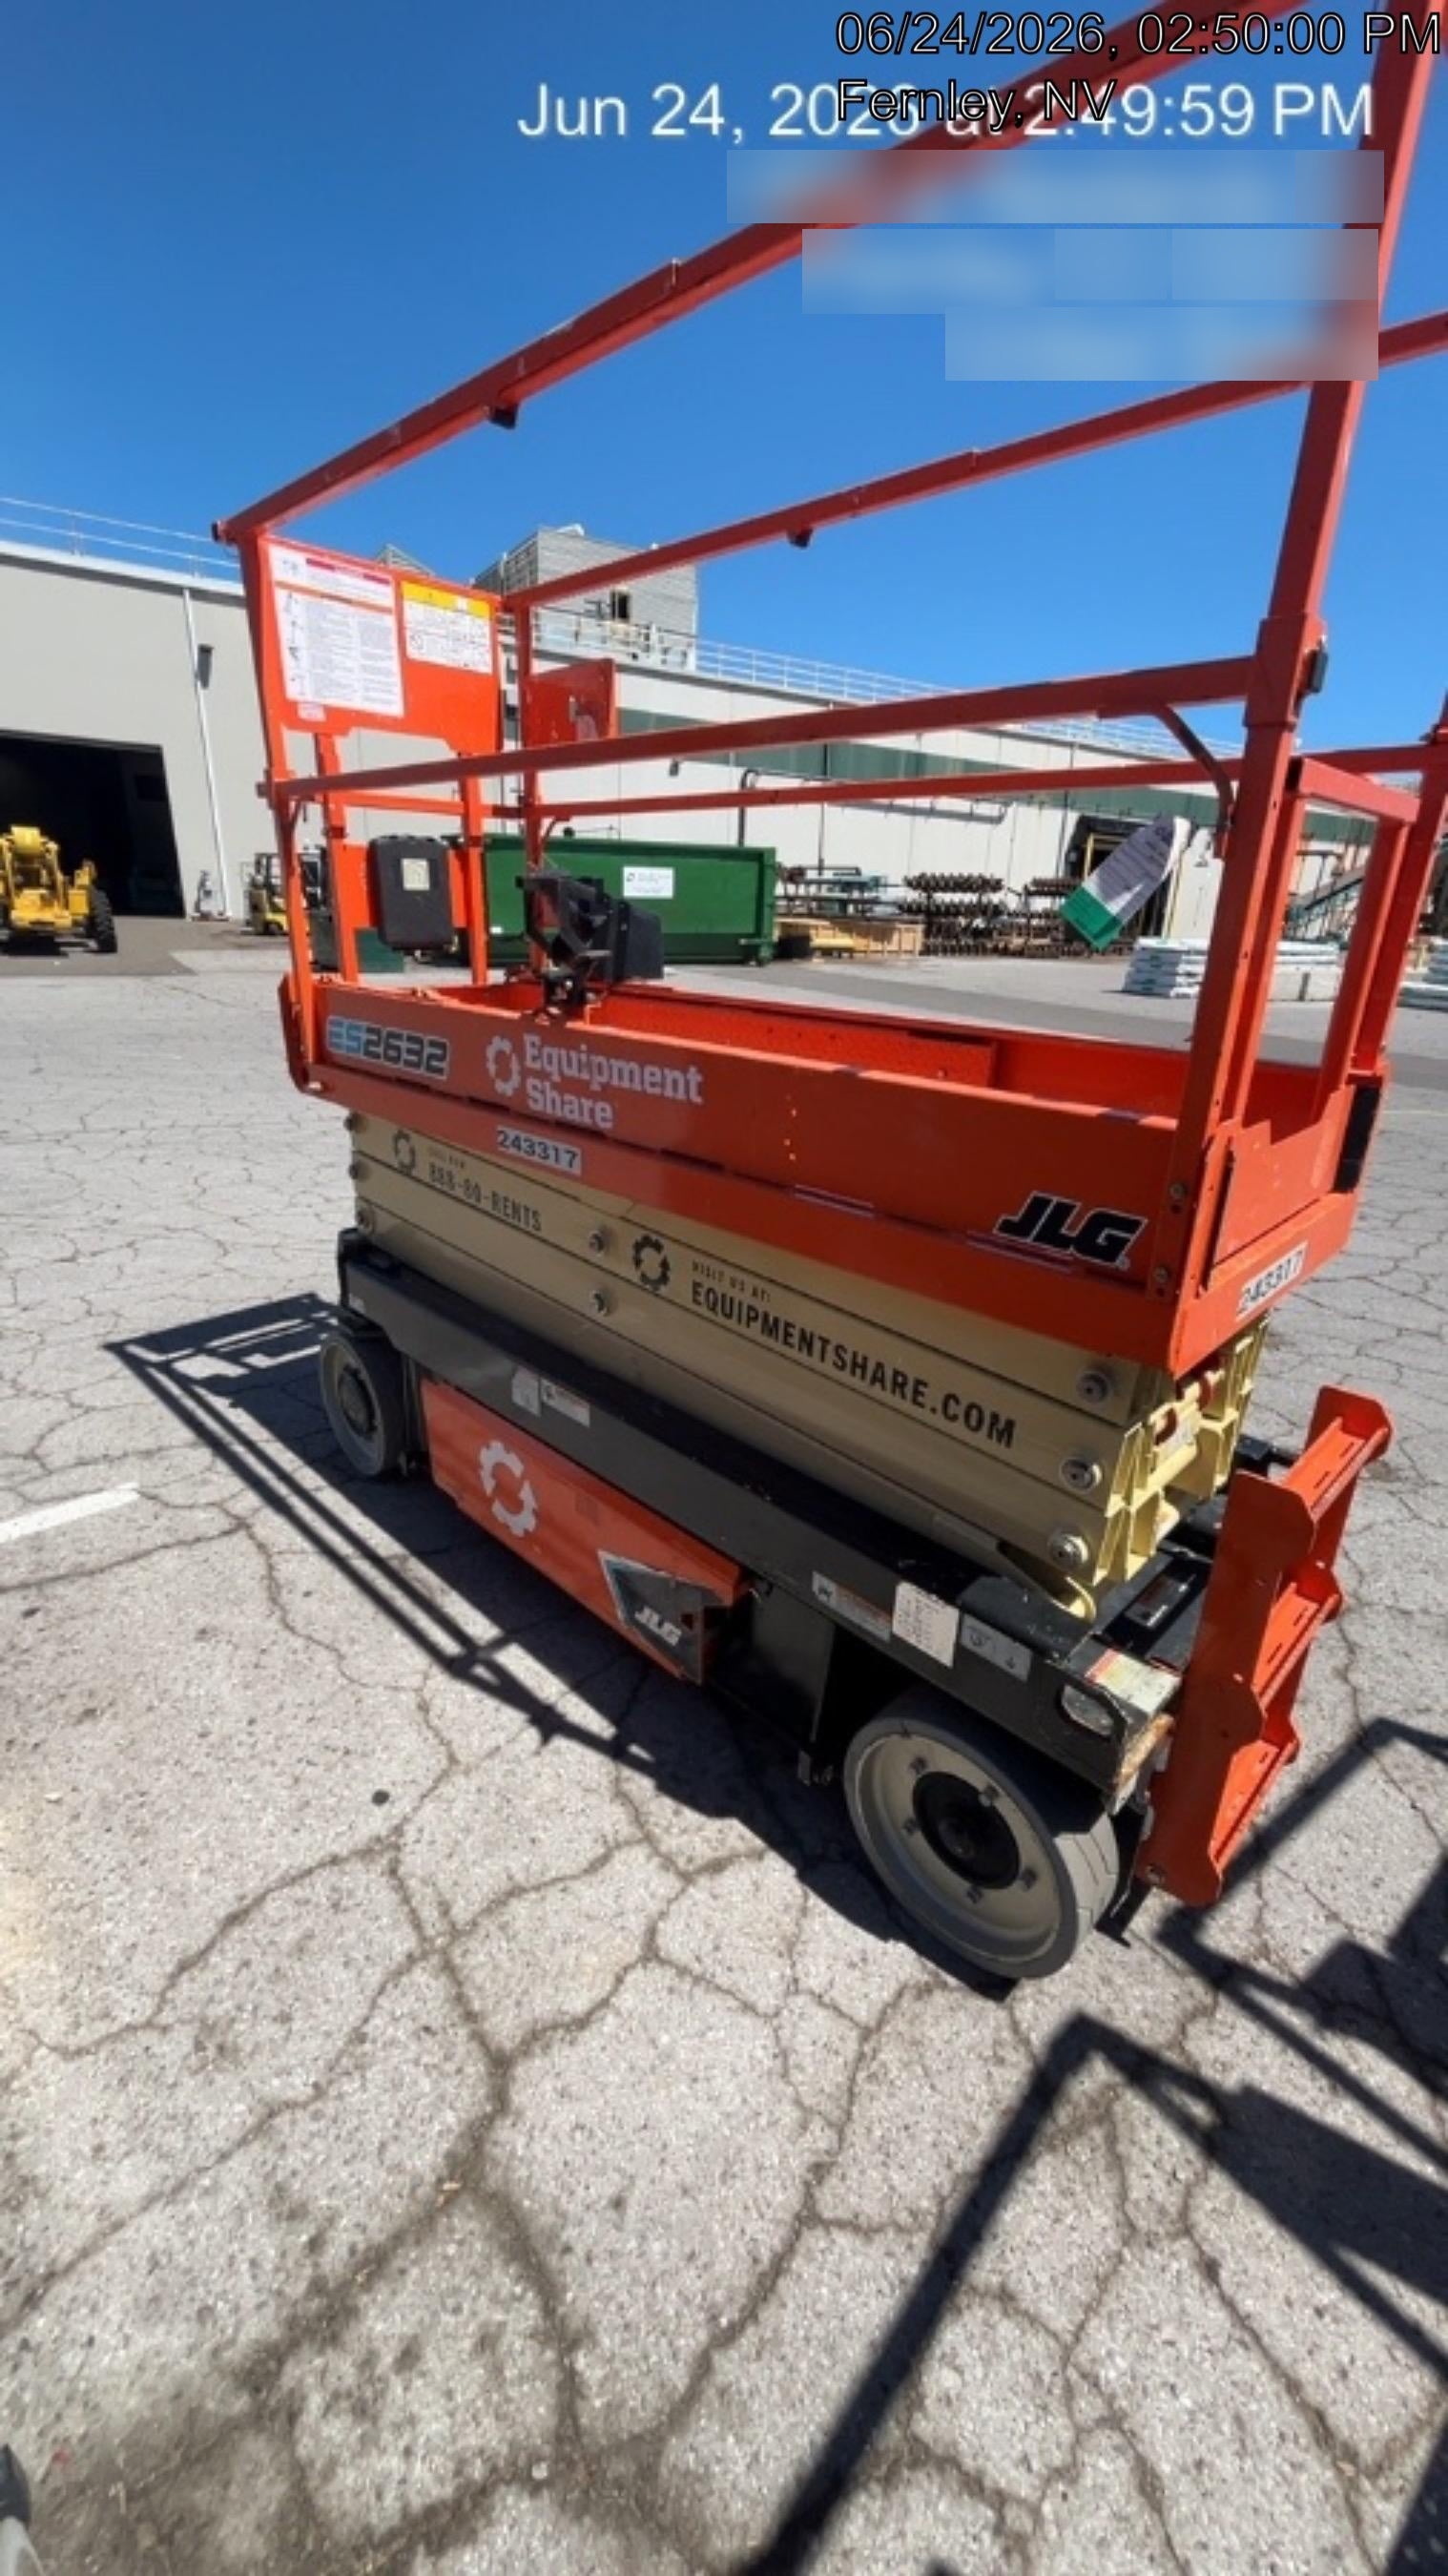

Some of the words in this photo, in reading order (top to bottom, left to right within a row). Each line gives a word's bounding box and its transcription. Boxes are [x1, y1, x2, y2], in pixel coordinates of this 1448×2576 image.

[327, 1015, 449, 1080] ES2632
[523, 1033, 704, 1104] Equipment
[526, 1078, 614, 1130] Share
[496, 1130, 579, 1170] 243317
[992, 1191, 1148, 1266] JLG
[692, 1279, 1017, 1448] EQUIPMENTSHARE.COM
[634, 1605, 683, 1647] JLG
